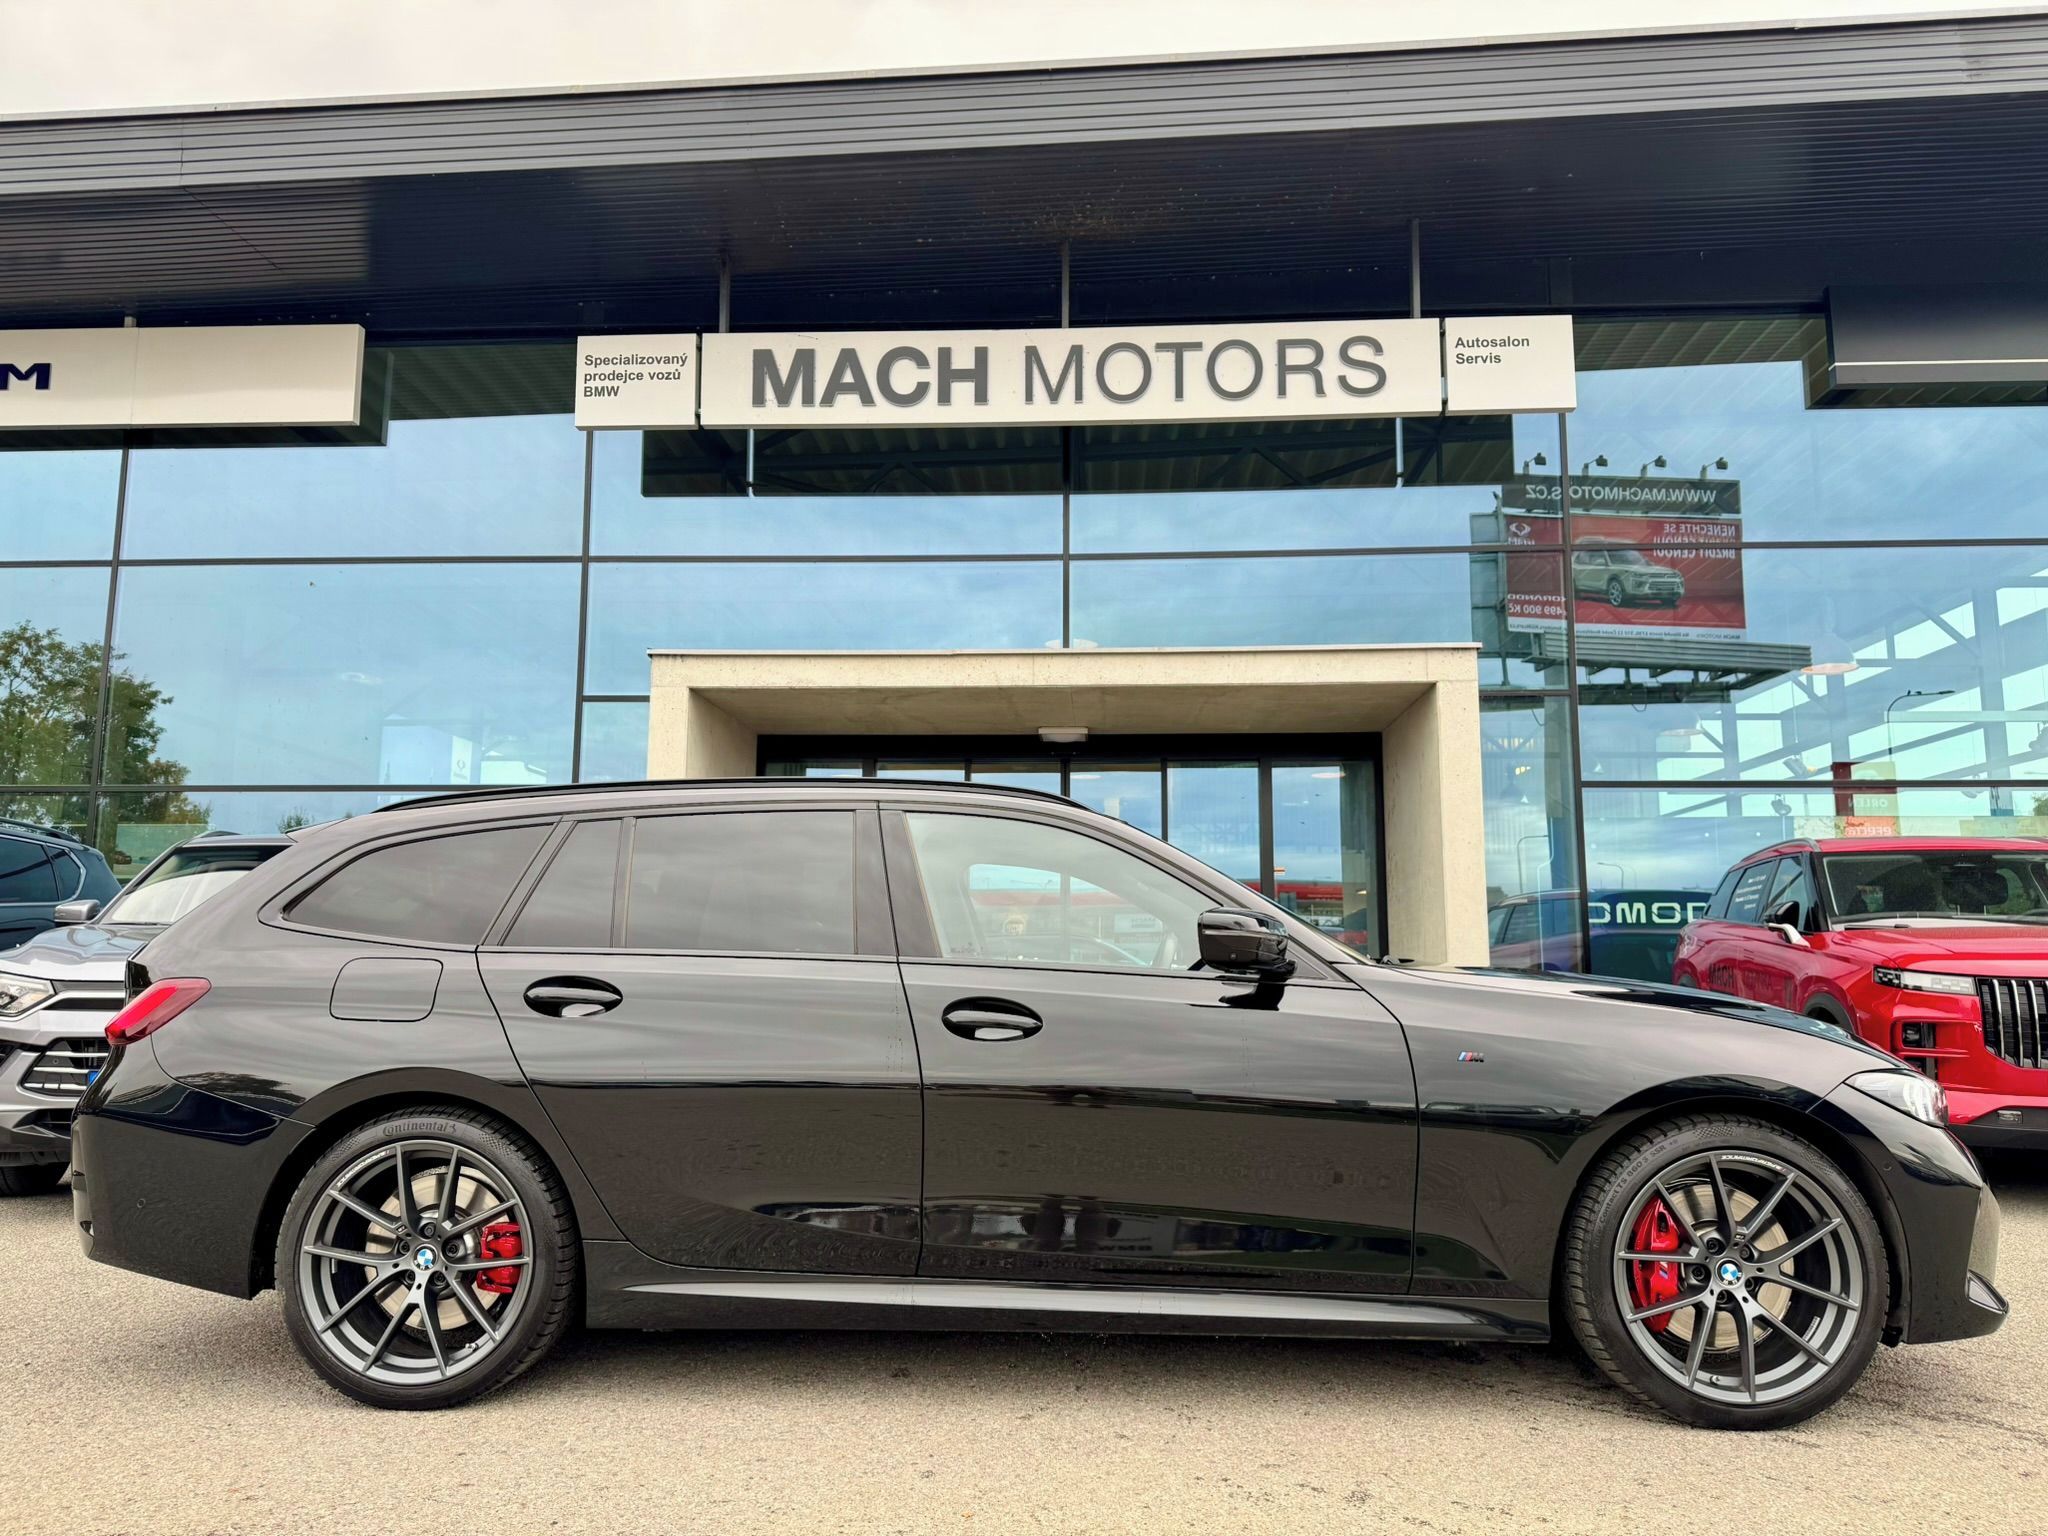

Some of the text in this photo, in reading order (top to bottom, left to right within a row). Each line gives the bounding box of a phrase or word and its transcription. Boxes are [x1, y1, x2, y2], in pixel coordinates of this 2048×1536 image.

[1455, 336, 1530, 349] Autosalon
[584, 353, 688, 368] Specializovaný
[1456, 352, 1502, 364] Servis
[583, 369, 681, 384] prodejce vozů
[751, 335, 1387, 408] MACH MOTORS
[583, 386, 620, 397] BMW
